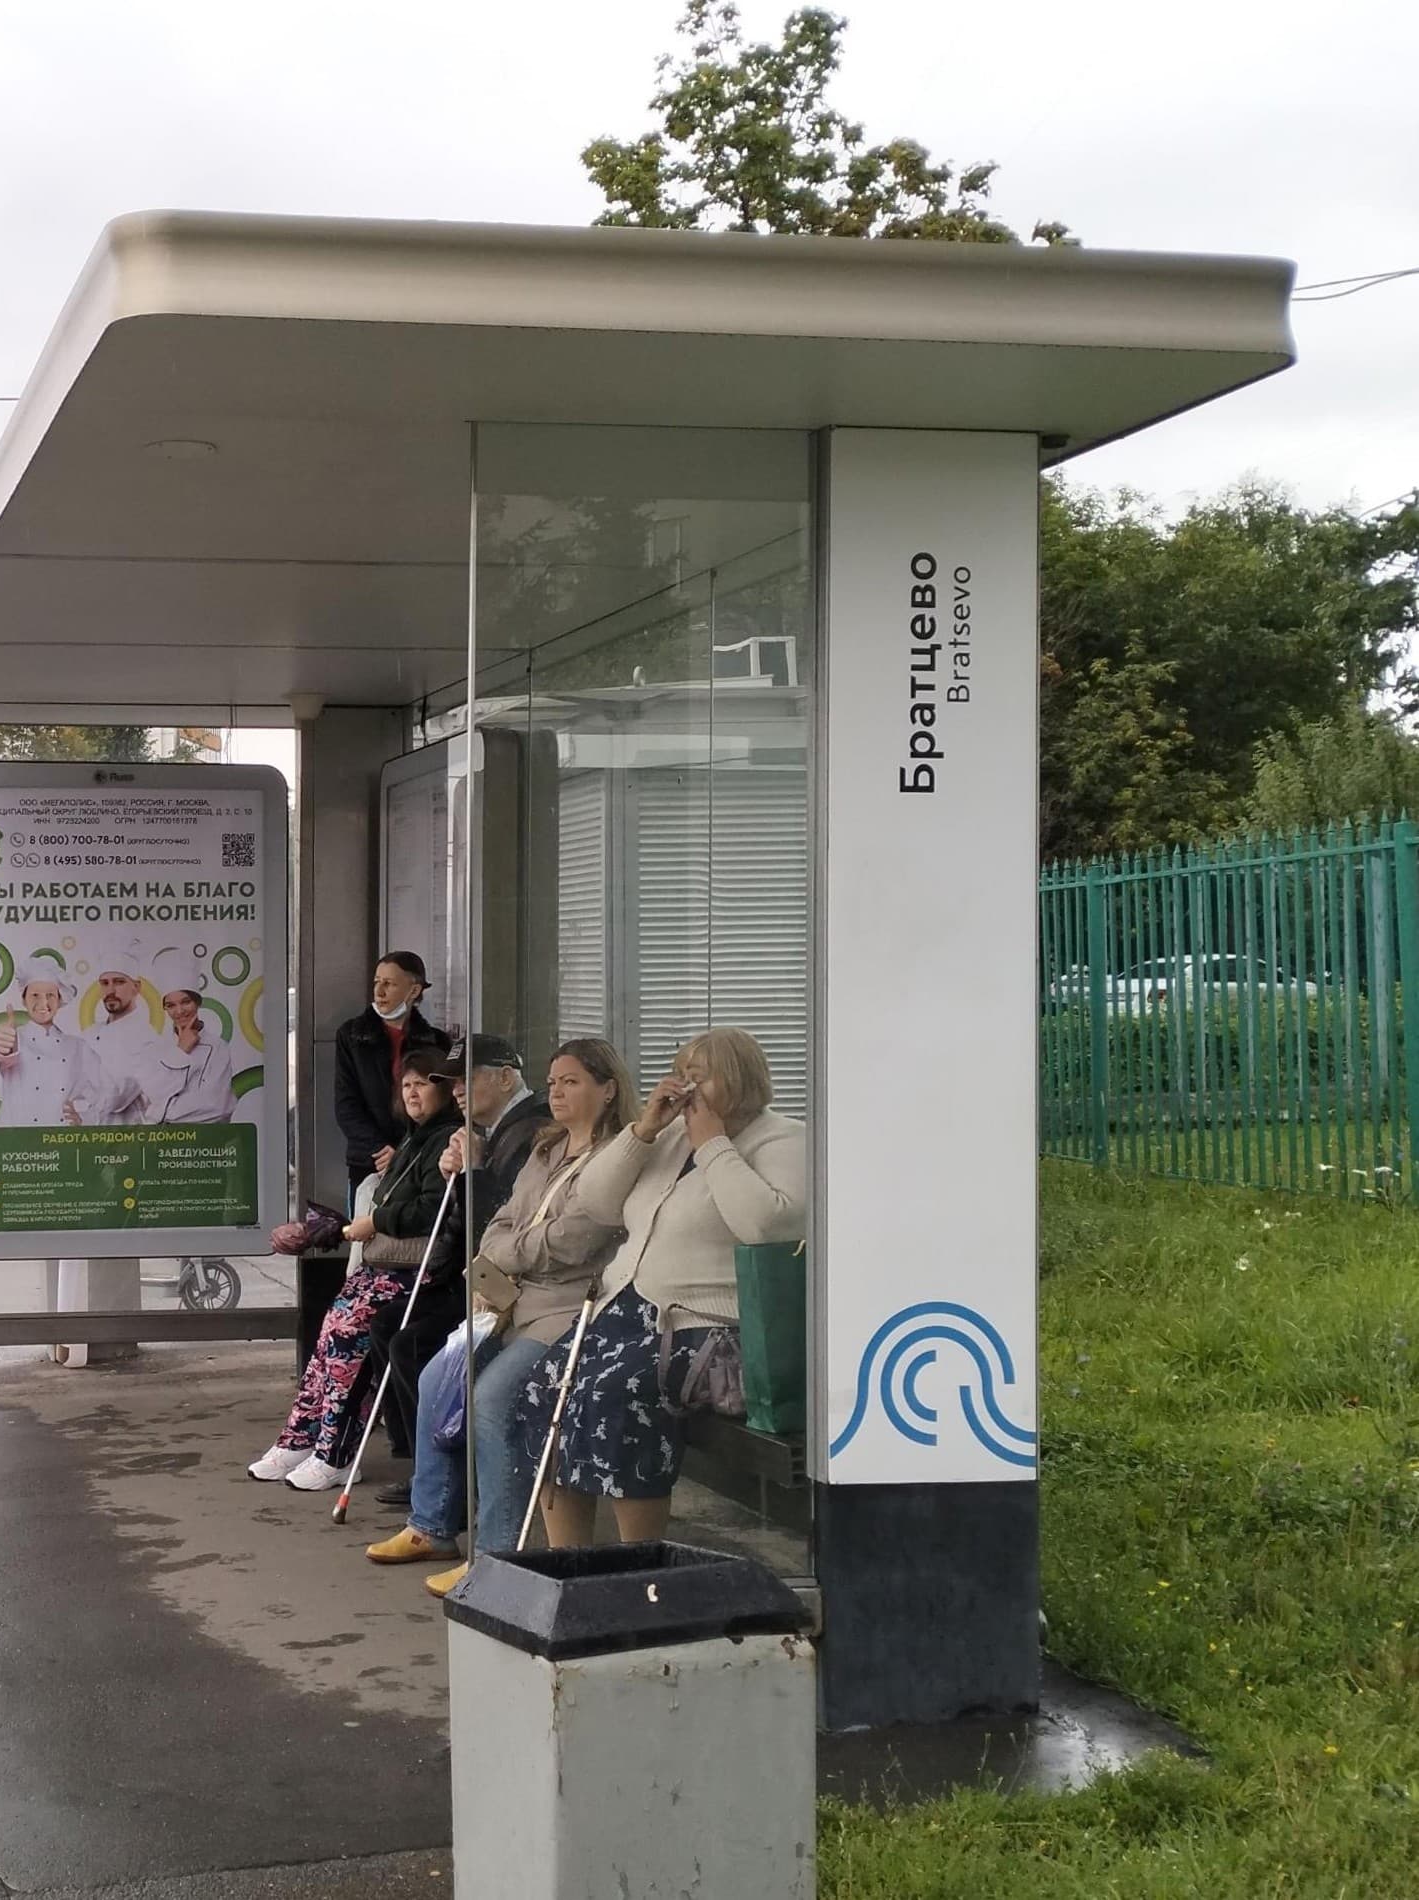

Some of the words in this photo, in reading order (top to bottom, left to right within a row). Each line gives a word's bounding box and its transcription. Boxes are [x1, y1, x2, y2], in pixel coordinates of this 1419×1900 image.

[946, 566, 971, 702] Bratsevo
[899, 551, 945, 793] Братцево
[29, 835, 36, 845] 8
[39, 834, 69, 845] (800)
[72, 835, 125, 845] 700-78-01
[44, 856, 51, 865] 8
[53, 855, 81, 866] (495)
[85, 855, 137, 865] 580-78-01
[21, 882, 138, 899] РАБОТАЕМ
[146, 882, 176, 898] НА
[183, 881, 256, 898] БЛАГО
[109, 904, 256, 922] ПОКОЛЕНИЯ!
[42, 1133, 89, 1144] РАБОТА
[92, 1132, 136, 1143] РЯДОМ
[137, 1132, 145, 1142] С
[148, 1131, 197, 1142] ДОМОМ
[1, 1150, 60, 1162] КУХОННЫЙ
[158, 1146, 237, 1158] ЗАВЕДУЮЩИЙ
[94, 1154, 130, 1165] ПОВАР
[158, 1159, 237, 1171] ПРОИЗВОДСТВОМ
[1, 1163, 60, 1173] РАБОТНИК
